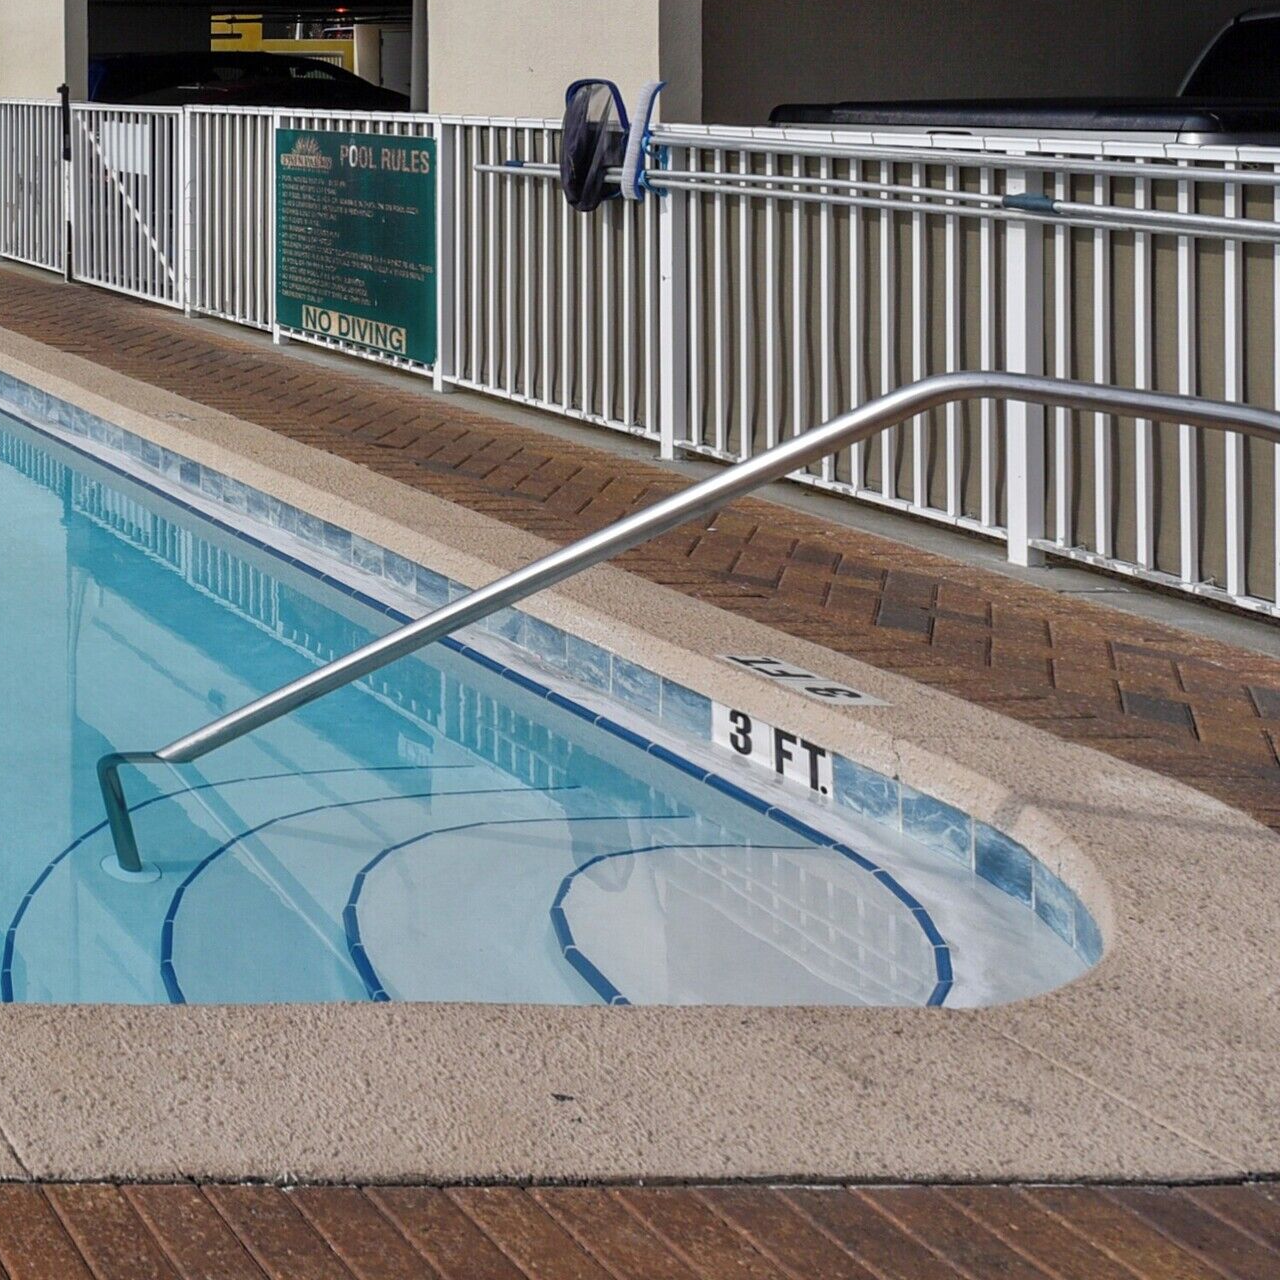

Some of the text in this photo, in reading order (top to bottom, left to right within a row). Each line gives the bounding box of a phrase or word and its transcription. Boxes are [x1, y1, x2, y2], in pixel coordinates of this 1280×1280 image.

[340, 144, 376, 169] POOL
[381, 148, 430, 174] RULES
[305, 307, 403, 352] NO DIVING
[805, 686, 862, 699] 3
[729, 709, 828, 795] 3 FT.
